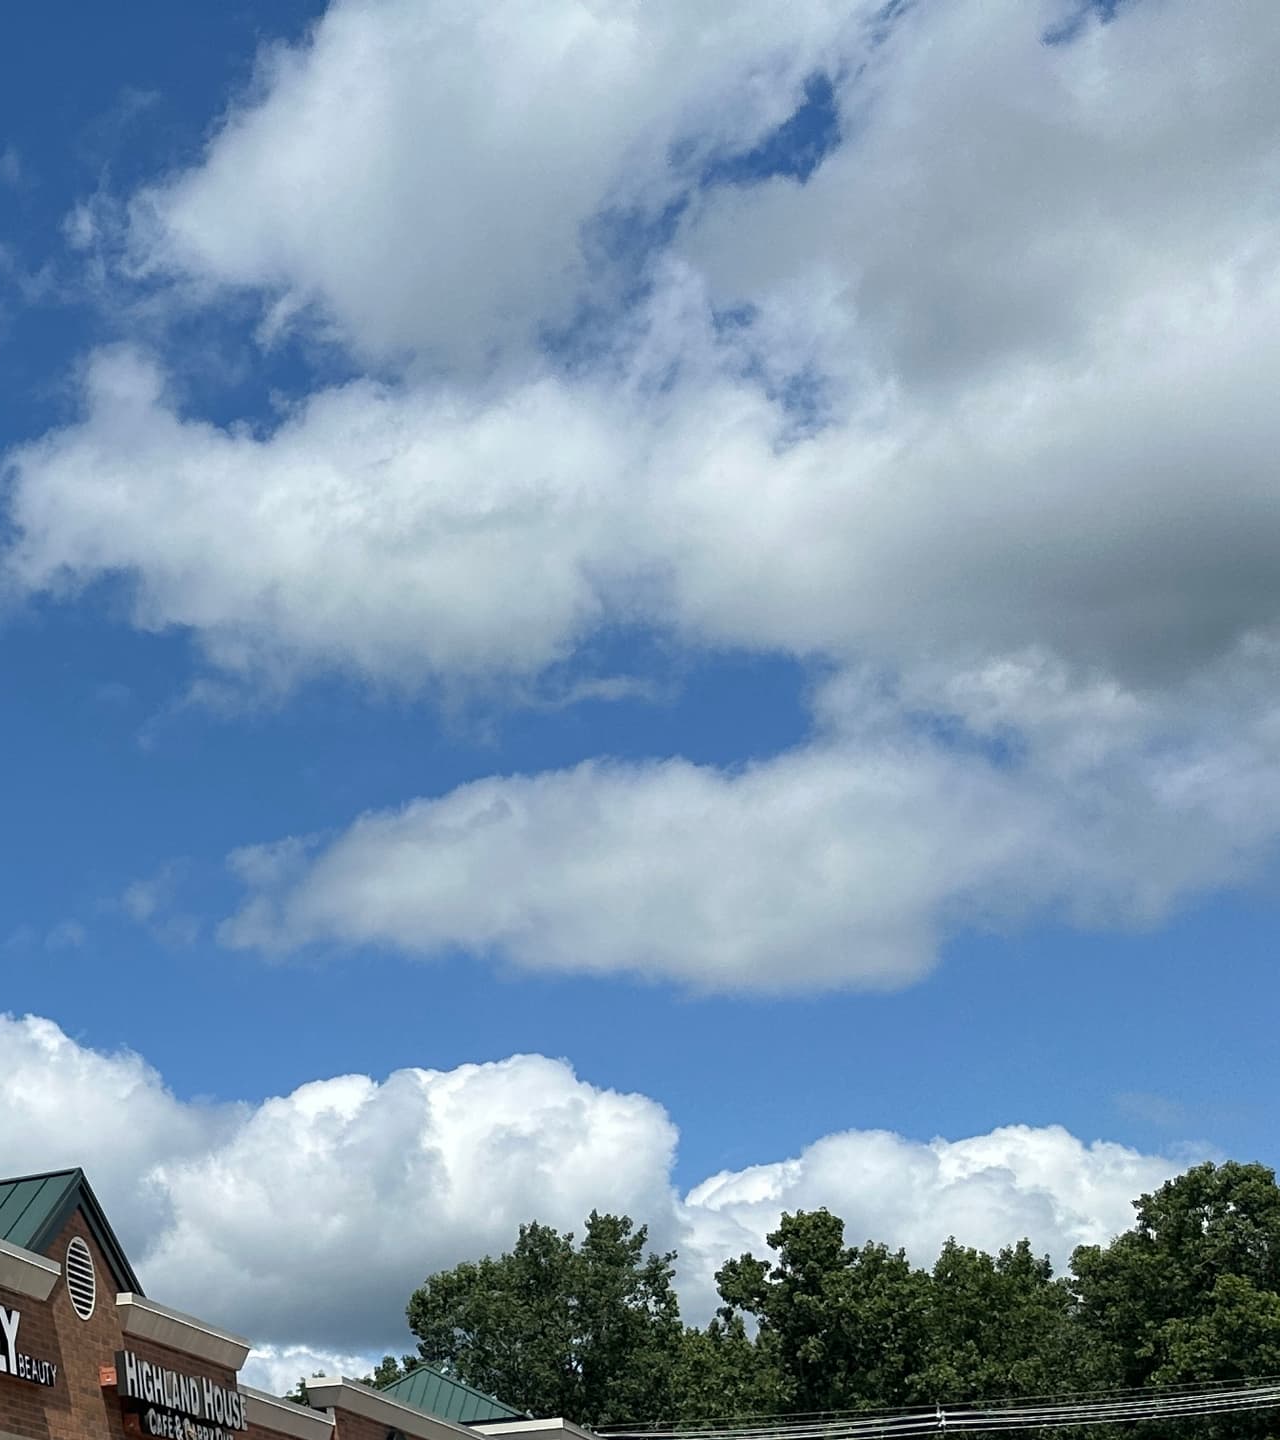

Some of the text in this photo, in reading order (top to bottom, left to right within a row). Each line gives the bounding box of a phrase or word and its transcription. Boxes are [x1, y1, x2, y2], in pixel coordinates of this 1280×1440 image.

[18, 1354, 57, 1386] BEAUTY
[124, 1350, 248, 1431] HIGHLAND HOUSE
[175, 1415, 184, 1440] &
